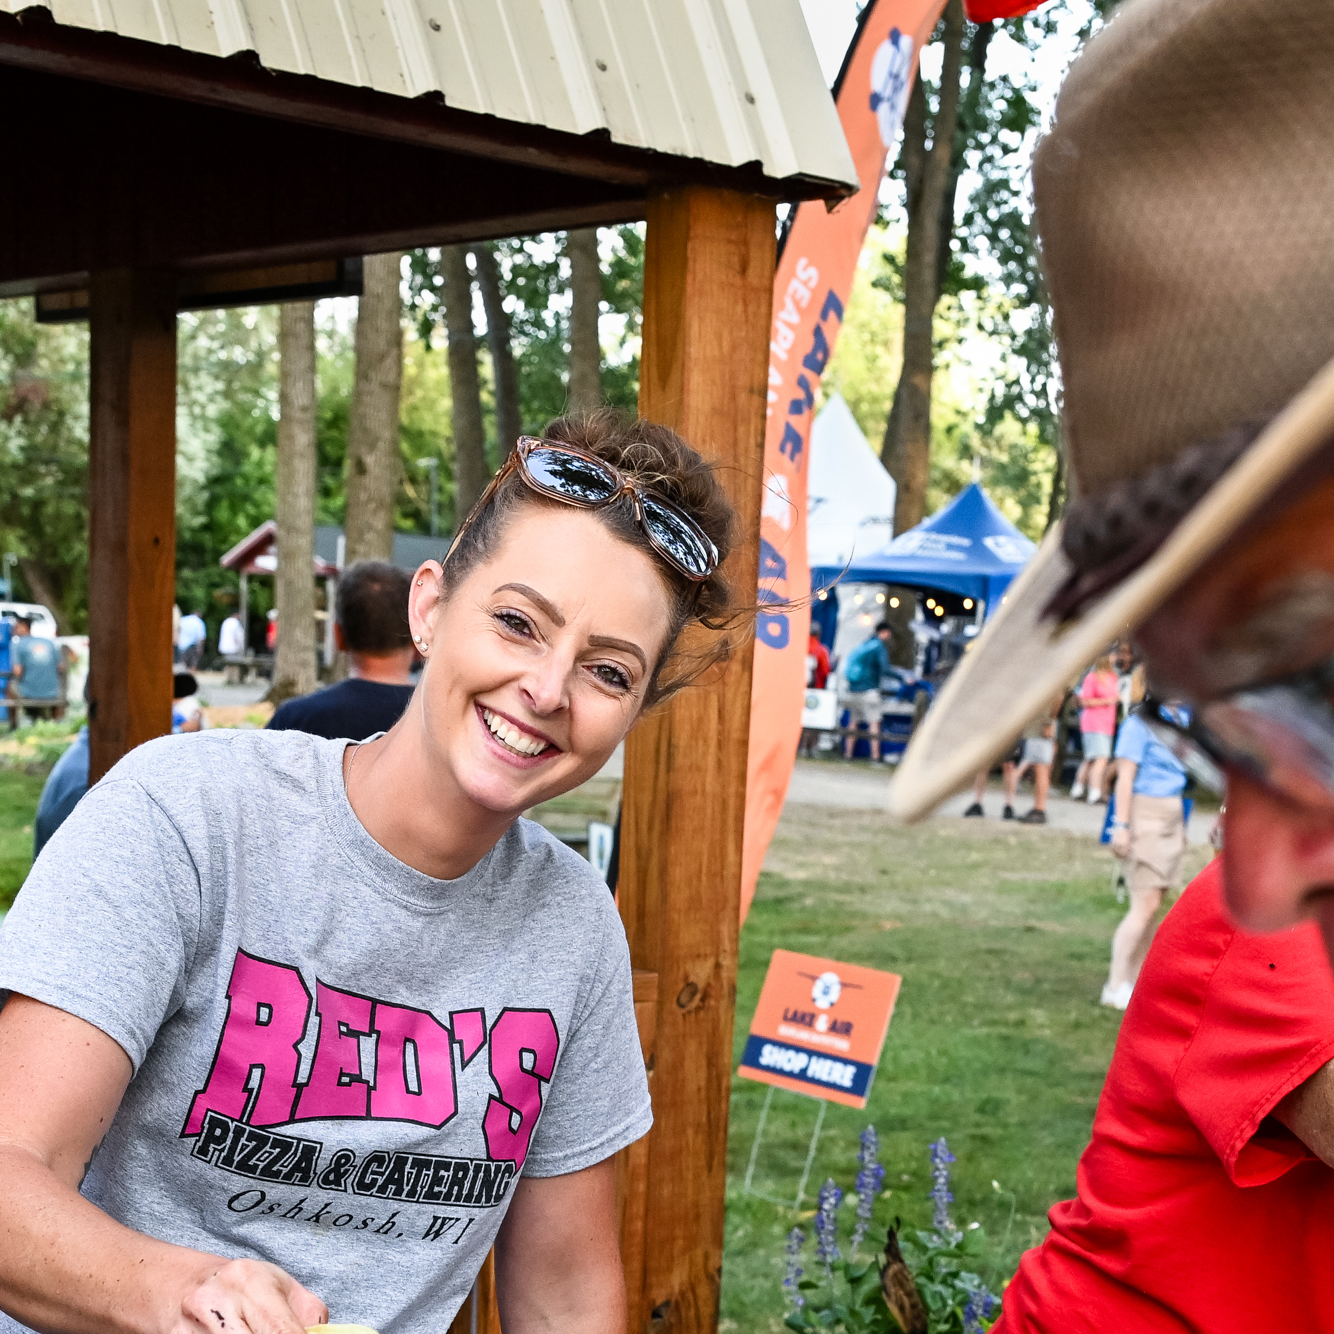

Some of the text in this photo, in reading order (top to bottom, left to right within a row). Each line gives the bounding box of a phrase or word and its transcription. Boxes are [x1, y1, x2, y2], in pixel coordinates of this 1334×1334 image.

[179, 946, 560, 1173] RED'S
[758, 1043, 857, 1088] SHOP HERE
[191, 1109, 518, 1207] PIZZA & CATERING
[227, 1189, 475, 1244] Oshkosh, WI
